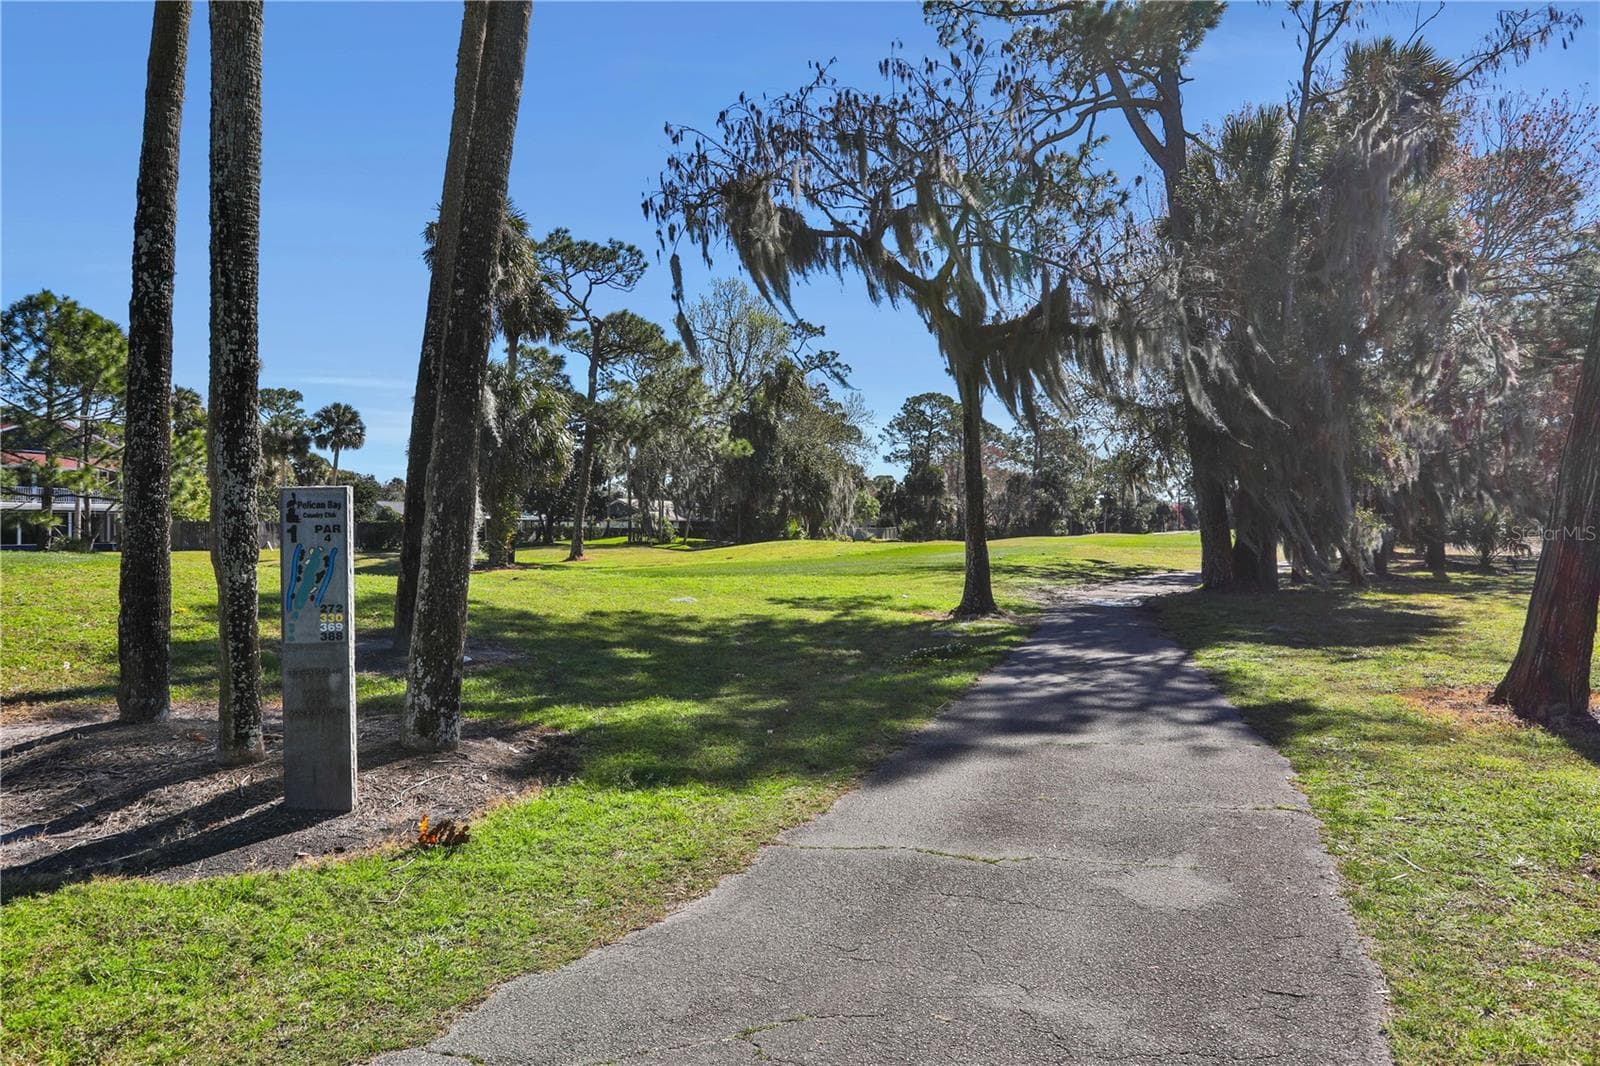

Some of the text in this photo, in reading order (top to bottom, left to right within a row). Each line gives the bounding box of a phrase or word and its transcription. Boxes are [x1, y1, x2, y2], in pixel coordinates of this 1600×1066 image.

[297, 501, 342, 510] Pelican Bay
[315, 525, 341, 533] PAR
[287, 525, 297, 543] 1
[324, 534, 331, 542] 4
[320, 604, 343, 613] 272
[320, 613, 343, 622] 330
[320, 623, 343, 632] 369
[320, 632, 343, 641] 388
